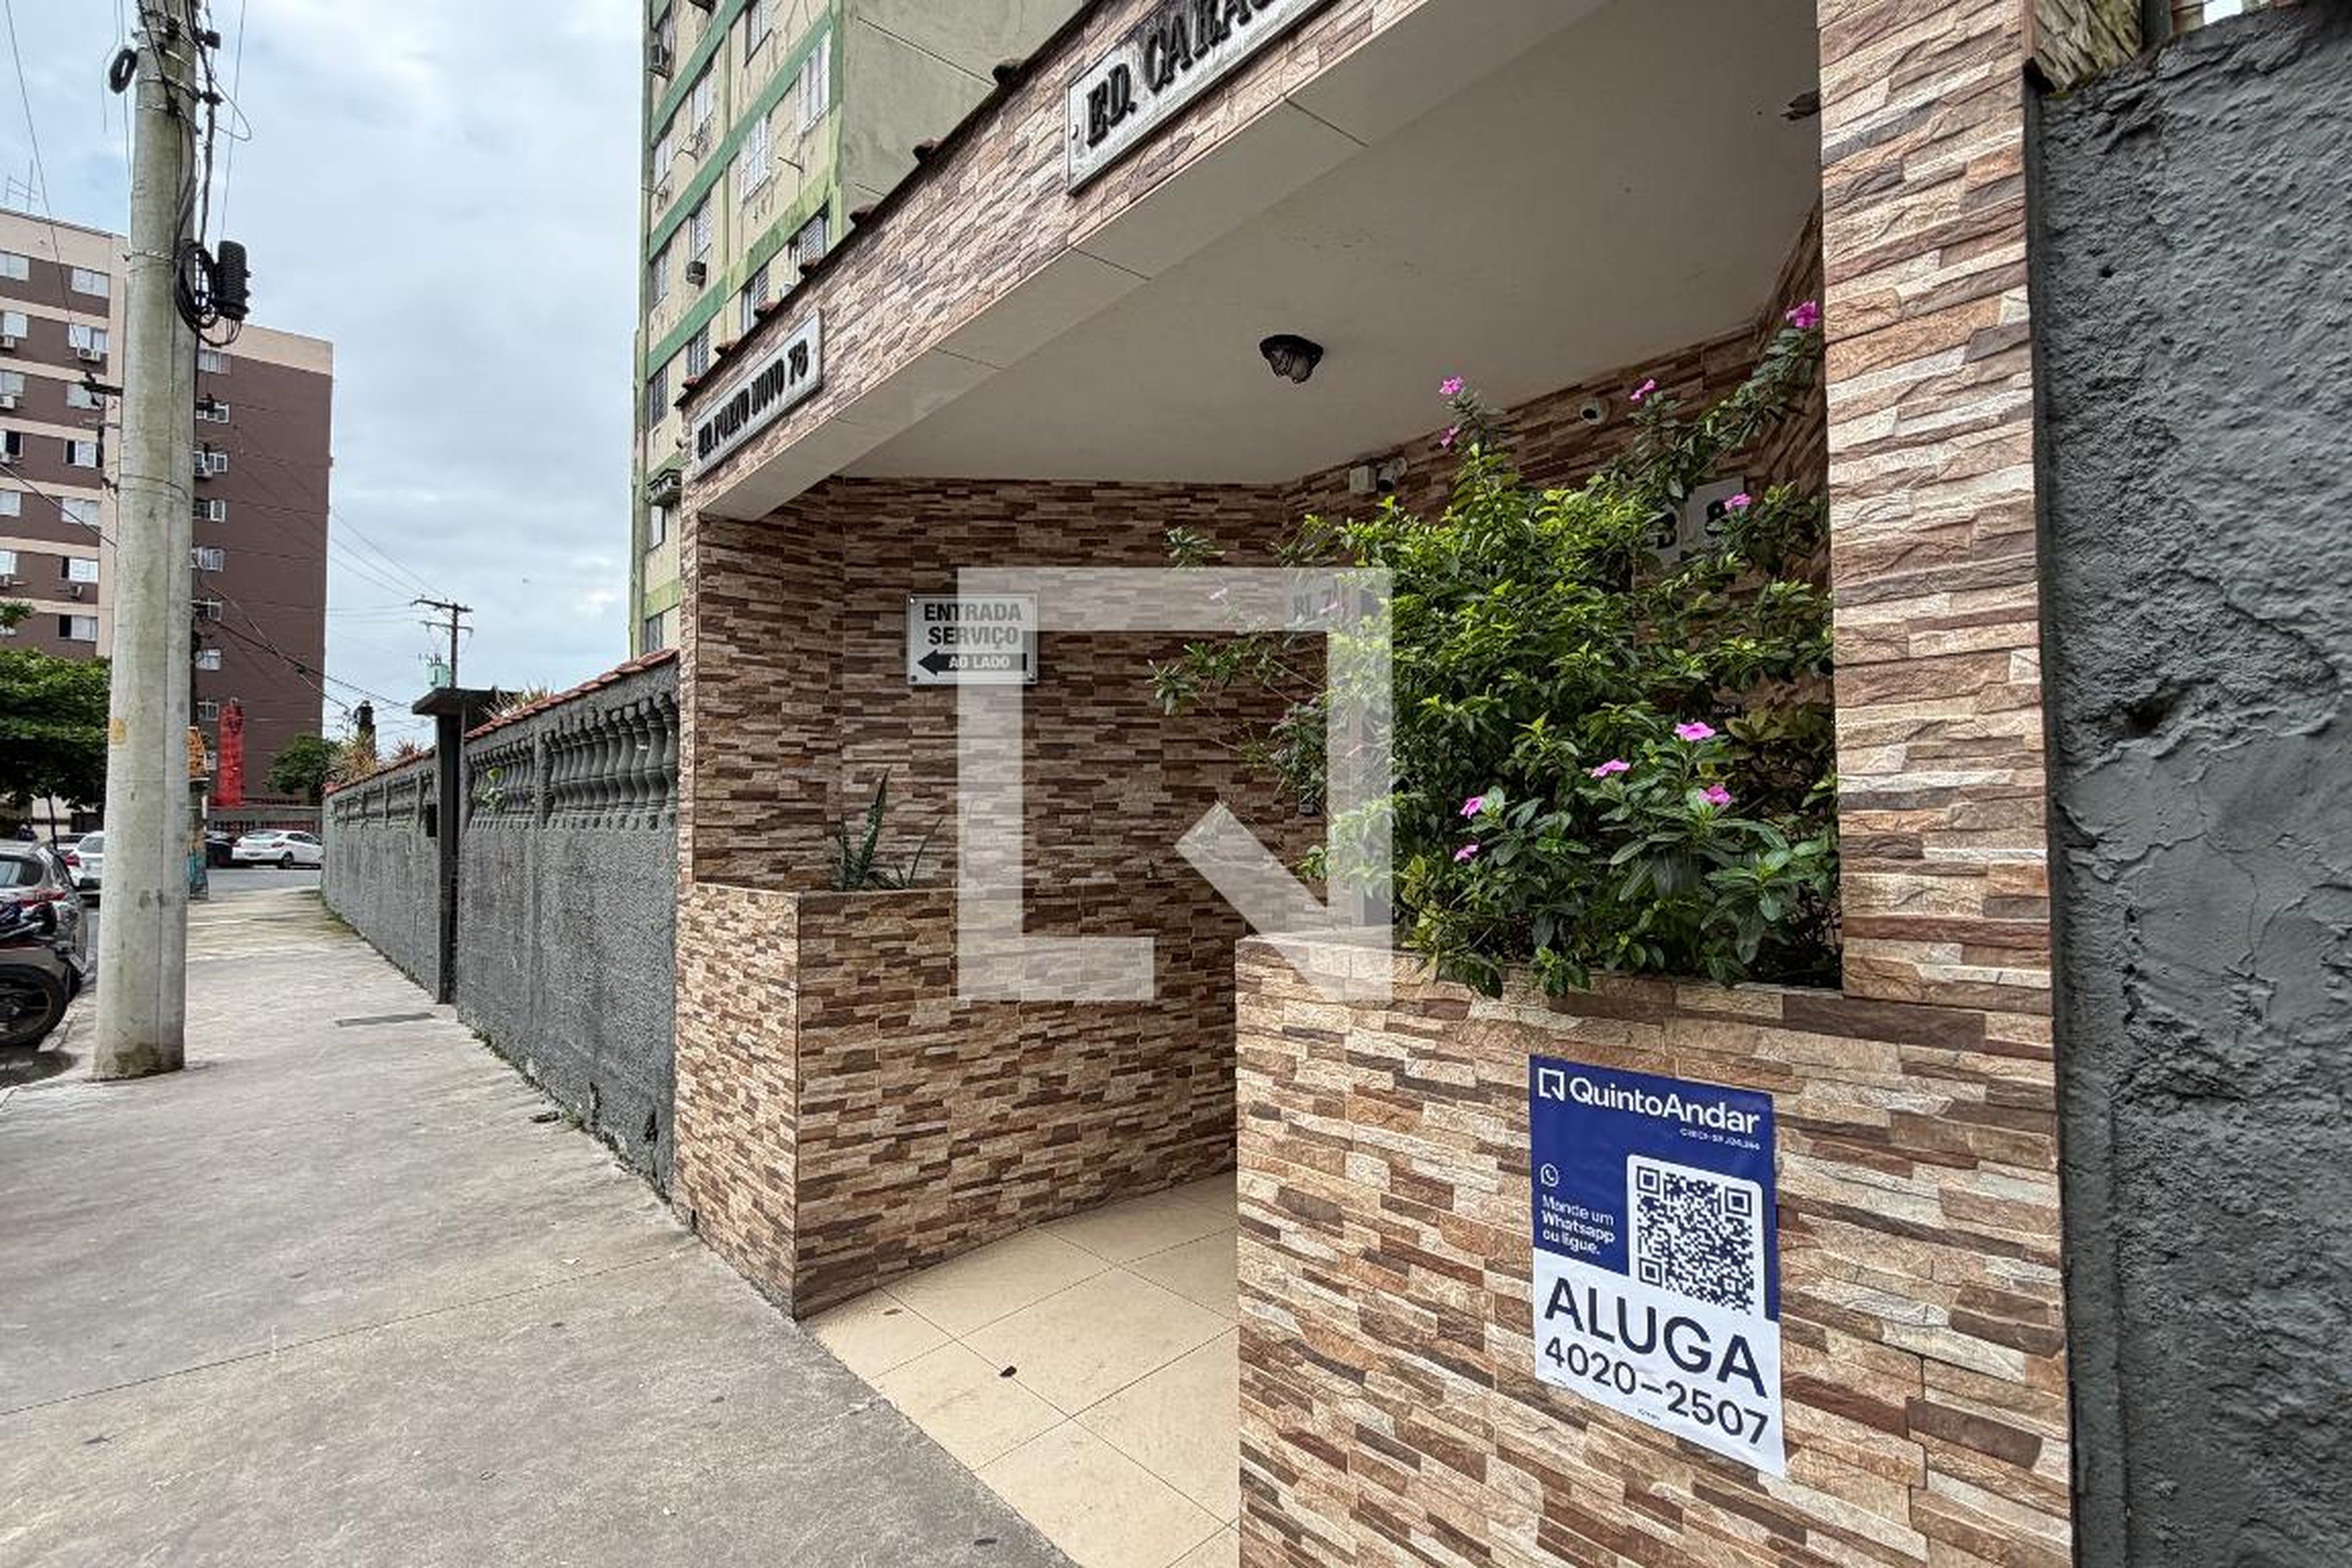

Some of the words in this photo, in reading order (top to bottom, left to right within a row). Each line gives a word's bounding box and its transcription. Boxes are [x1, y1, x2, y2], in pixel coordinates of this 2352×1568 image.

[1087, 63, 1136, 148] ED.
[924, 603, 1022, 621] ENTRADA
[928, 626, 1019, 649] SERVIÇO
[949, 655, 968, 668] AO
[973, 655, 1010, 668] LADO
[1569, 1077, 1761, 1134] QuintoAndar
[1543, 1194, 1589, 1219] Mande
[1591, 1211, 1614, 1226] um
[1544, 1229, 1559, 1242] ou
[1545, 1277, 1768, 1399] ALUGA
[1545, 1336, 1769, 1445] 4020-2507
